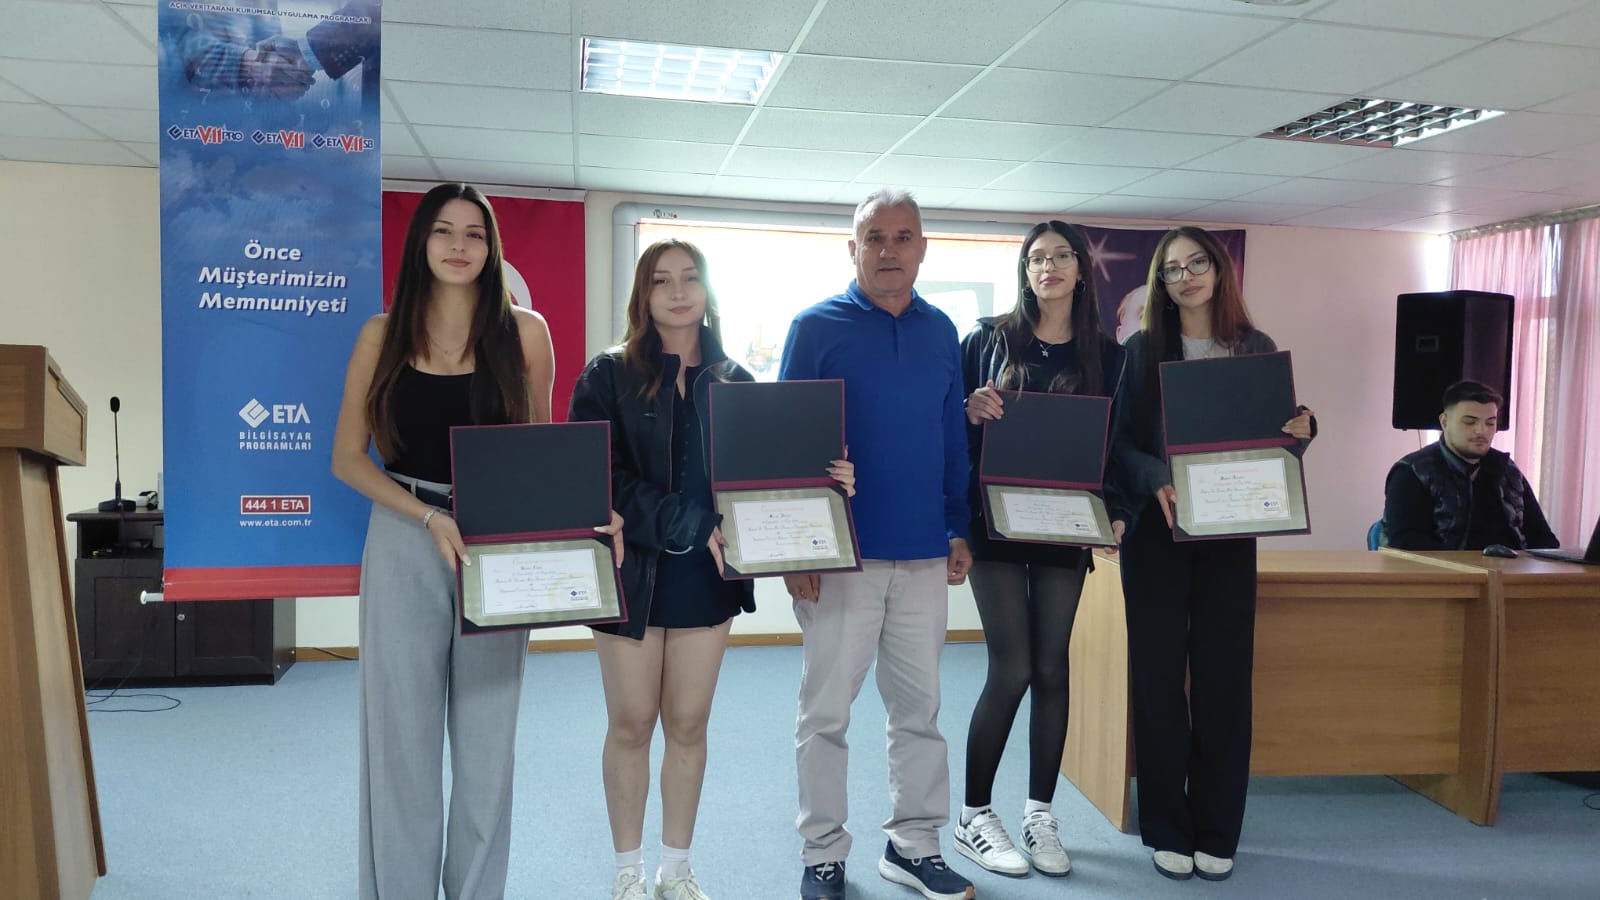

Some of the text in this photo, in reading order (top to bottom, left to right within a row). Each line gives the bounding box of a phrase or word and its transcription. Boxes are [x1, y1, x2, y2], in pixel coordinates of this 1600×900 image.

[277, 10, 318, 19] UYGULAMA
[244, 239, 302, 260] Önce
[198, 266, 347, 289] Müşterimizin
[198, 292, 348, 317] Memnuniyeti
[272, 402, 311, 424] ETA
[239, 429, 311, 441] BİLGİSAYAR
[239, 441, 312, 451] PROGRAMLARI
[245, 499, 305, 511] 444 1 ETA
[239, 518, 312, 527] www.eta.com.tr
